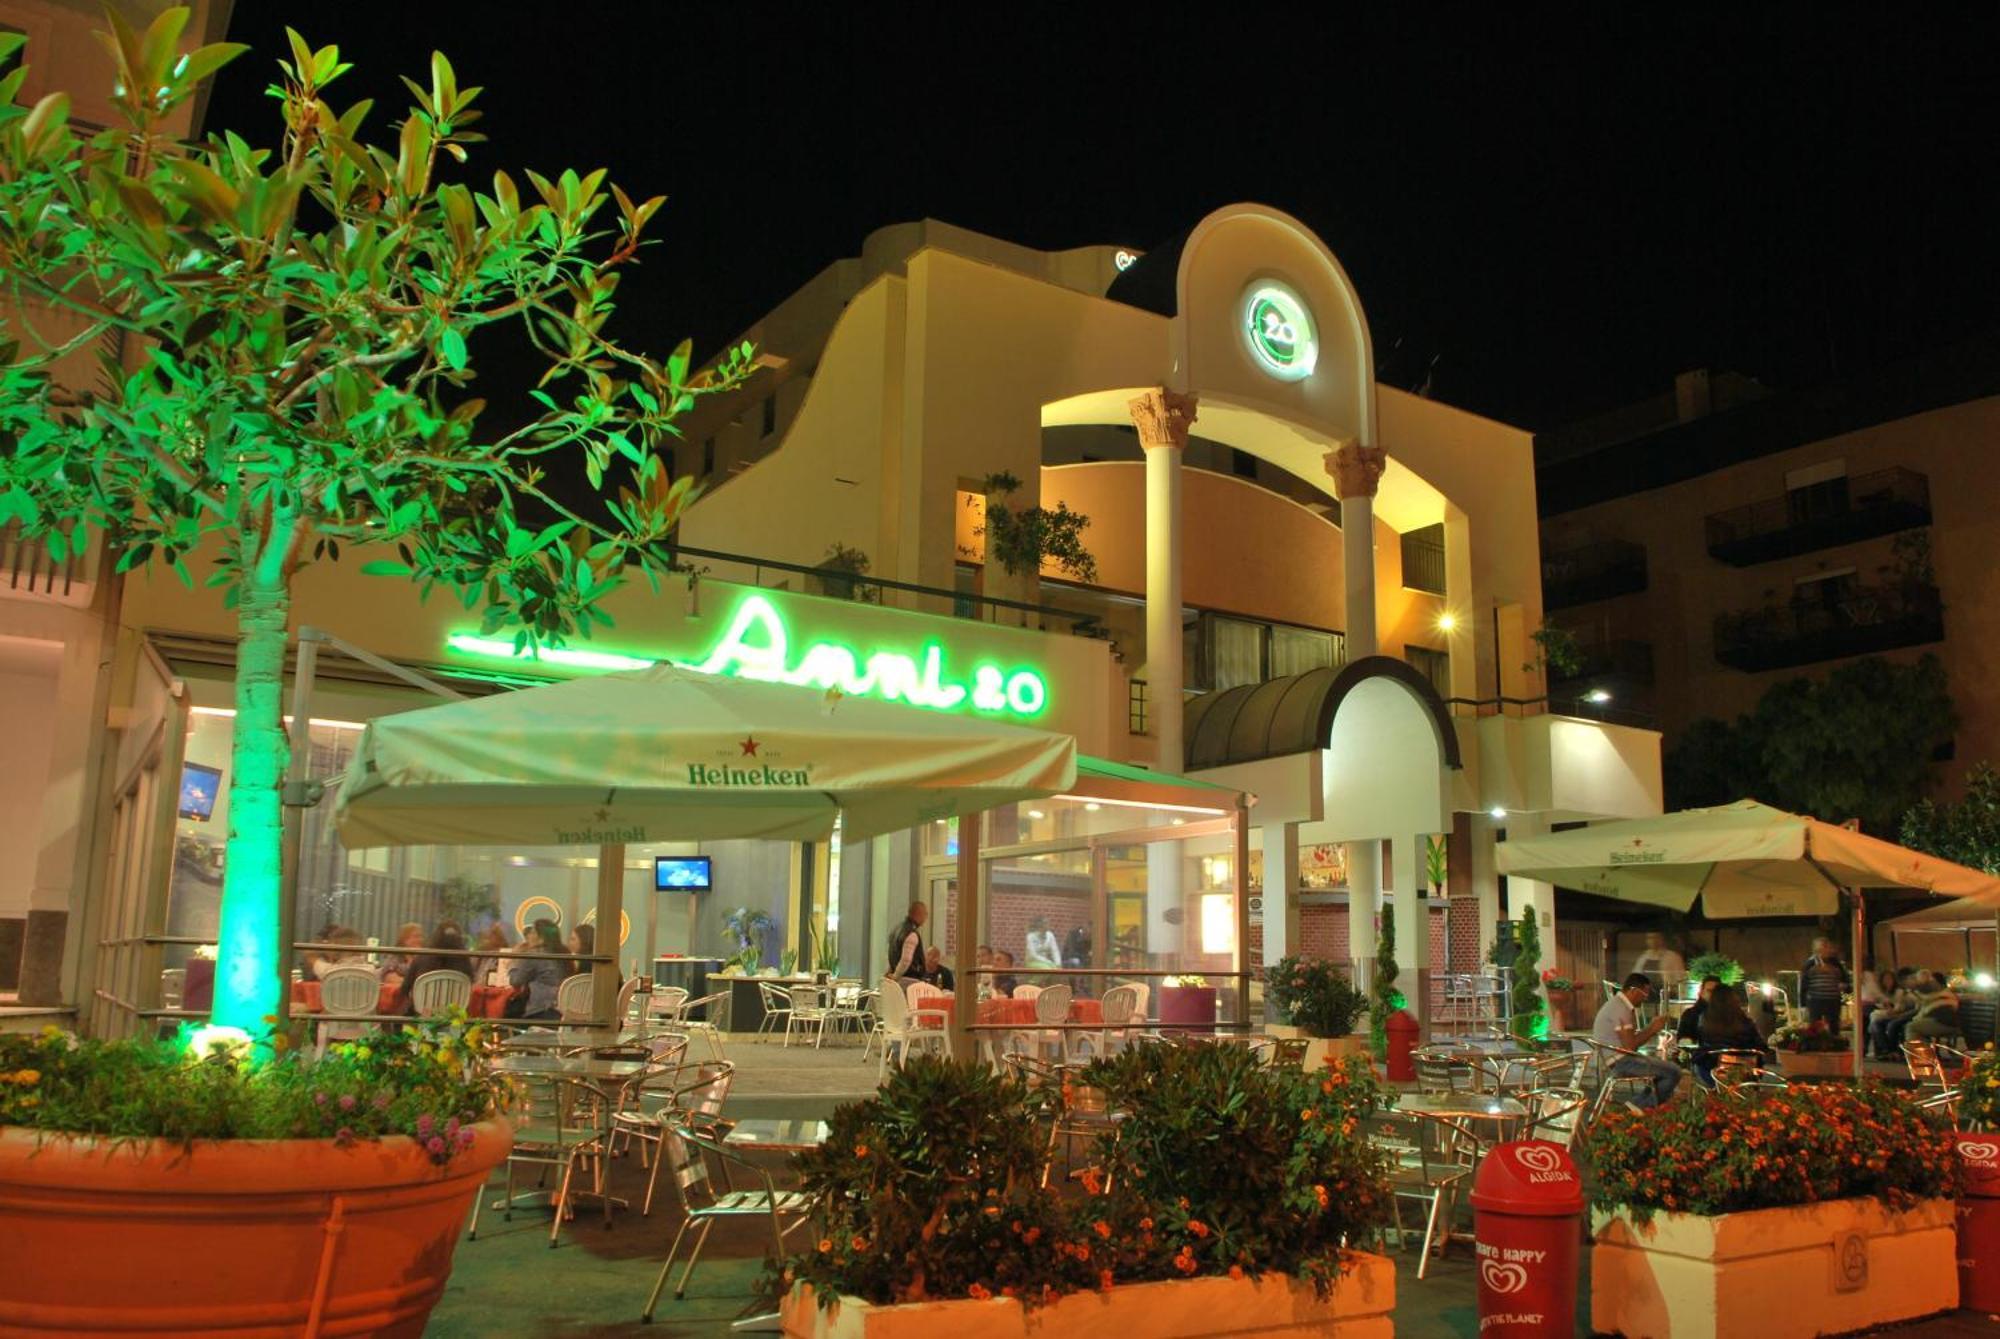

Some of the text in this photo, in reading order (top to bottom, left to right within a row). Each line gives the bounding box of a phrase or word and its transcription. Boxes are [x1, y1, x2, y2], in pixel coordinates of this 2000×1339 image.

[972, 664, 1045, 713] 20
[687, 763, 809, 786] Heineken
[1530, 1171, 1573, 1185] ALGIDA
